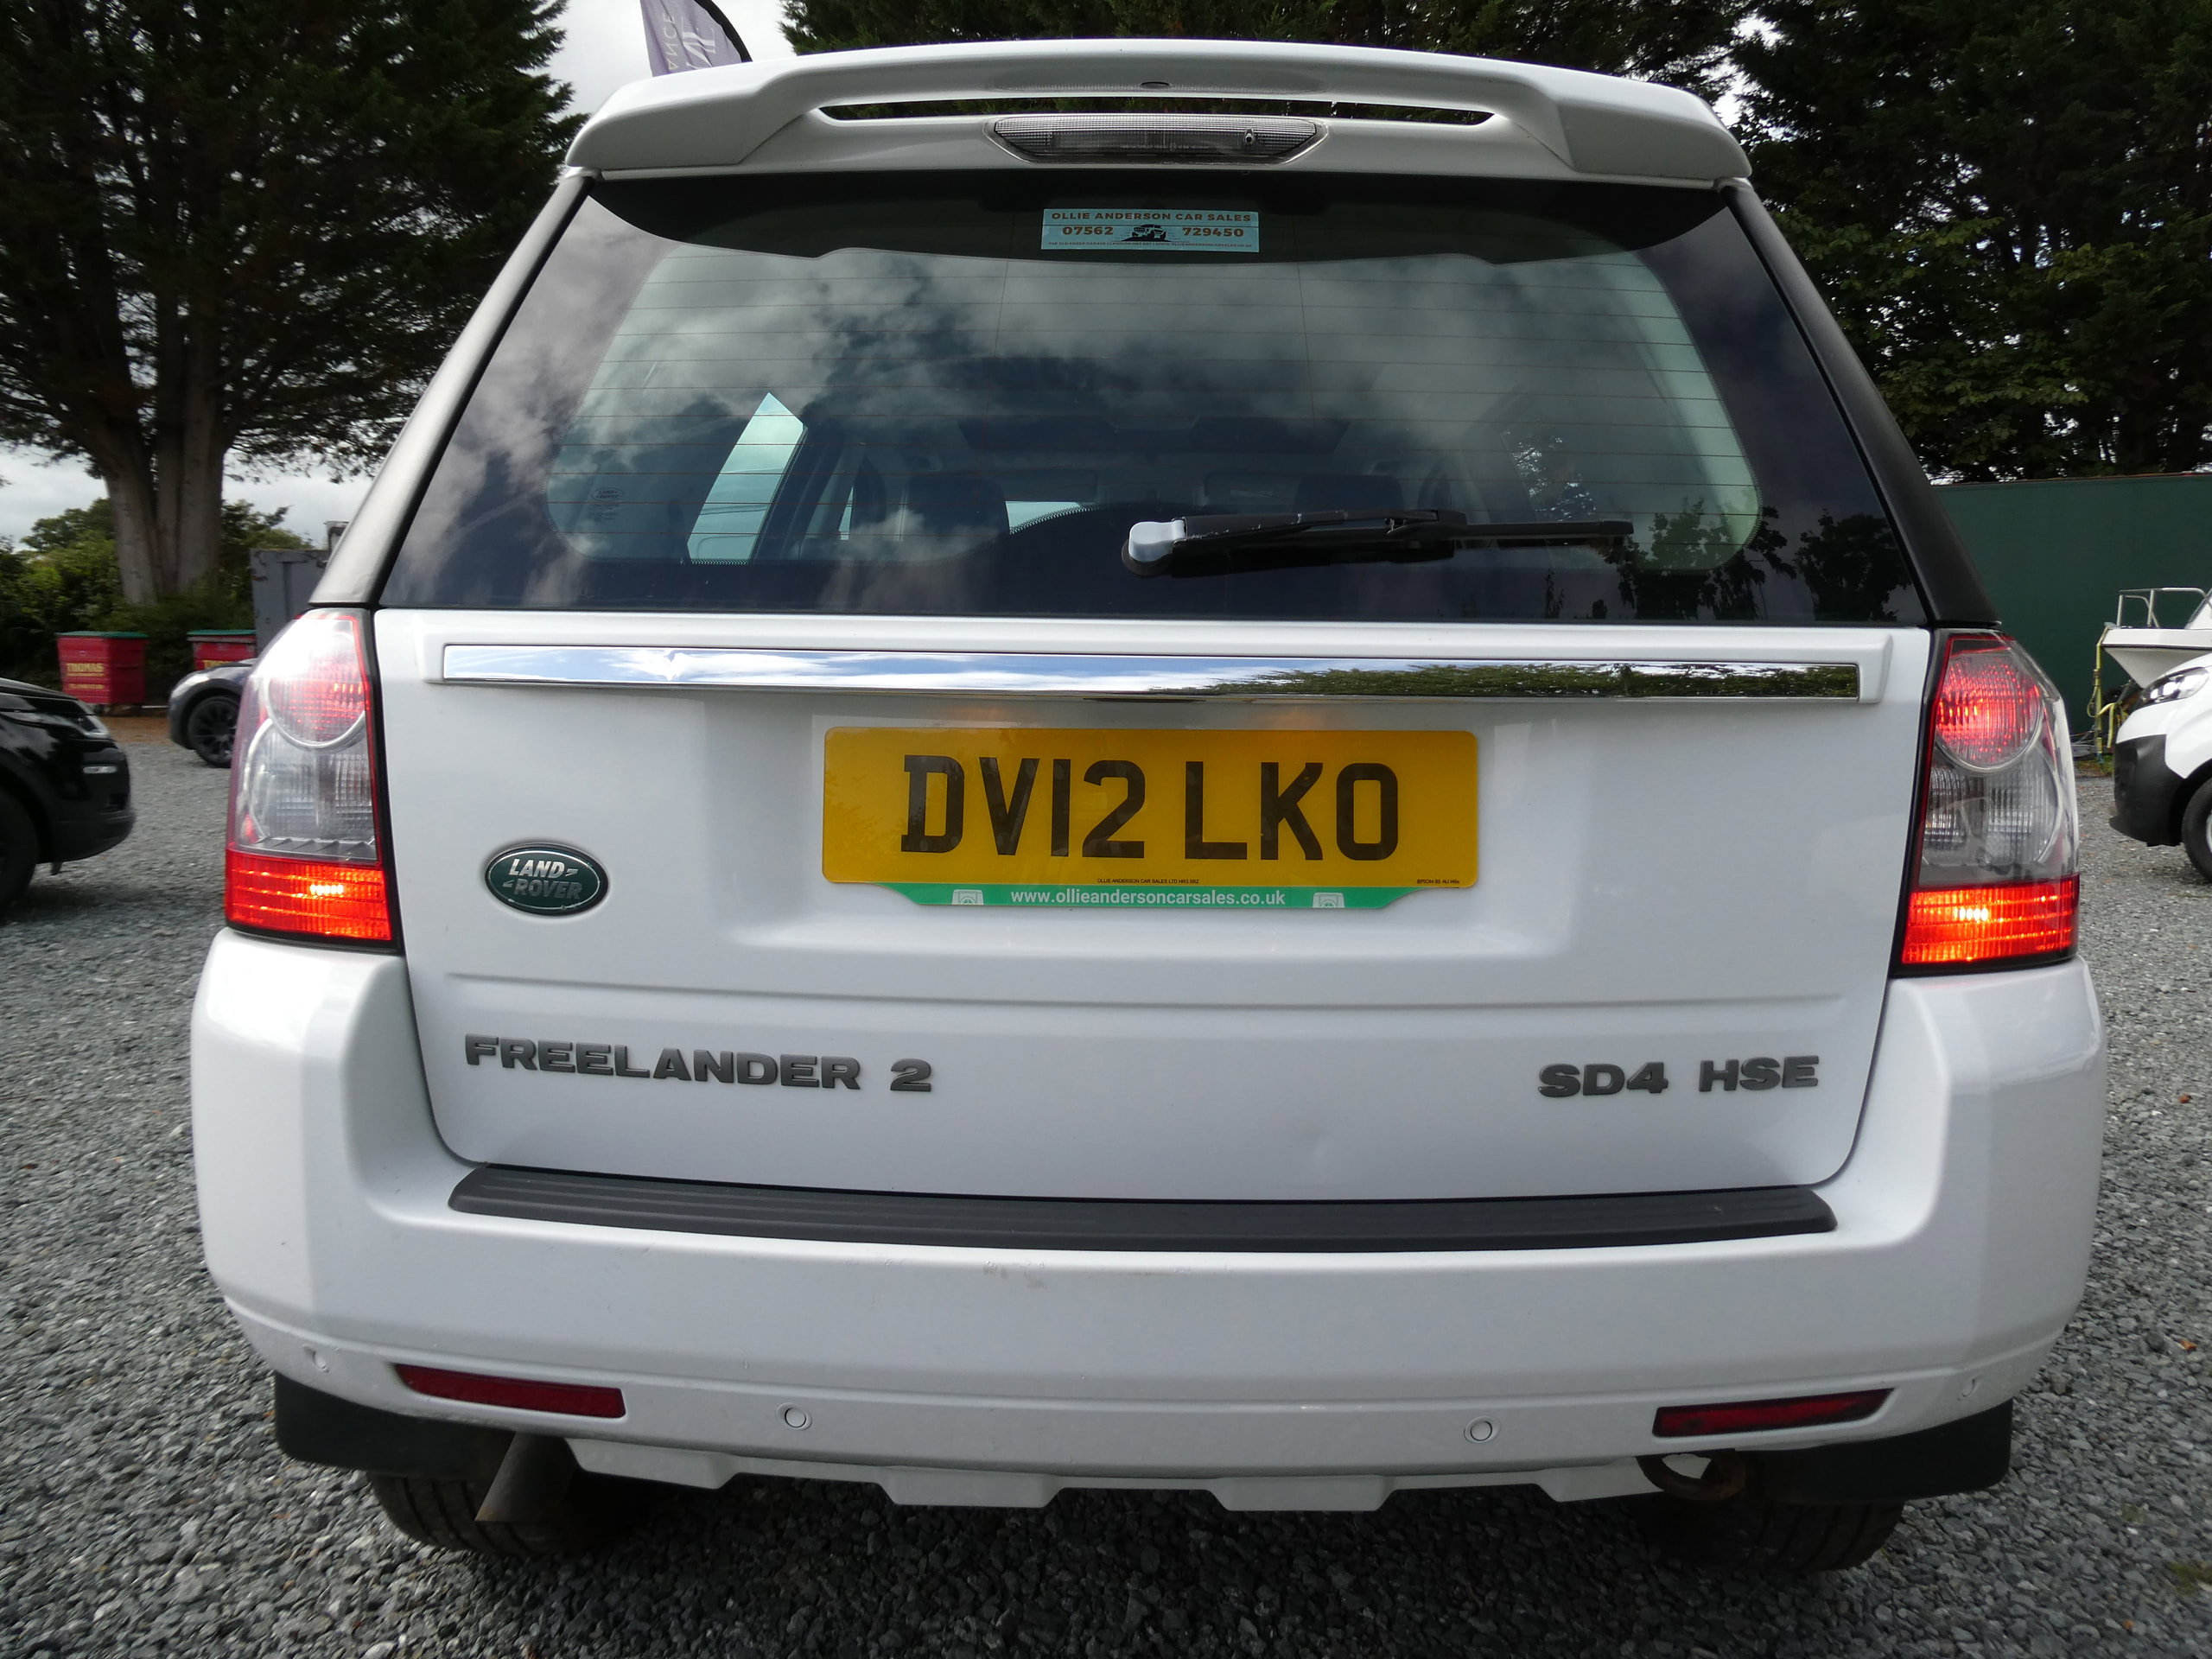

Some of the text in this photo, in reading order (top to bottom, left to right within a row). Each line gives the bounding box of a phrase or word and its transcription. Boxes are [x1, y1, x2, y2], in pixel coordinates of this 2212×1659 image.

[1207, 213, 1251, 222] SALES
[1062, 226, 1244, 238] 07562 729450
[66, 663, 105, 672] THOMAS
[900, 754, 1400, 861] DV12 LKO
[509, 858, 564, 878] LAND
[513, 878, 582, 899] ROVER
[1011, 888, 1286, 905] www.ollieandersoncarsales.co.uk
[465, 1033, 932, 1093] FREELANDER 2
[1538, 1055, 1820, 1098] SD4 HSE
